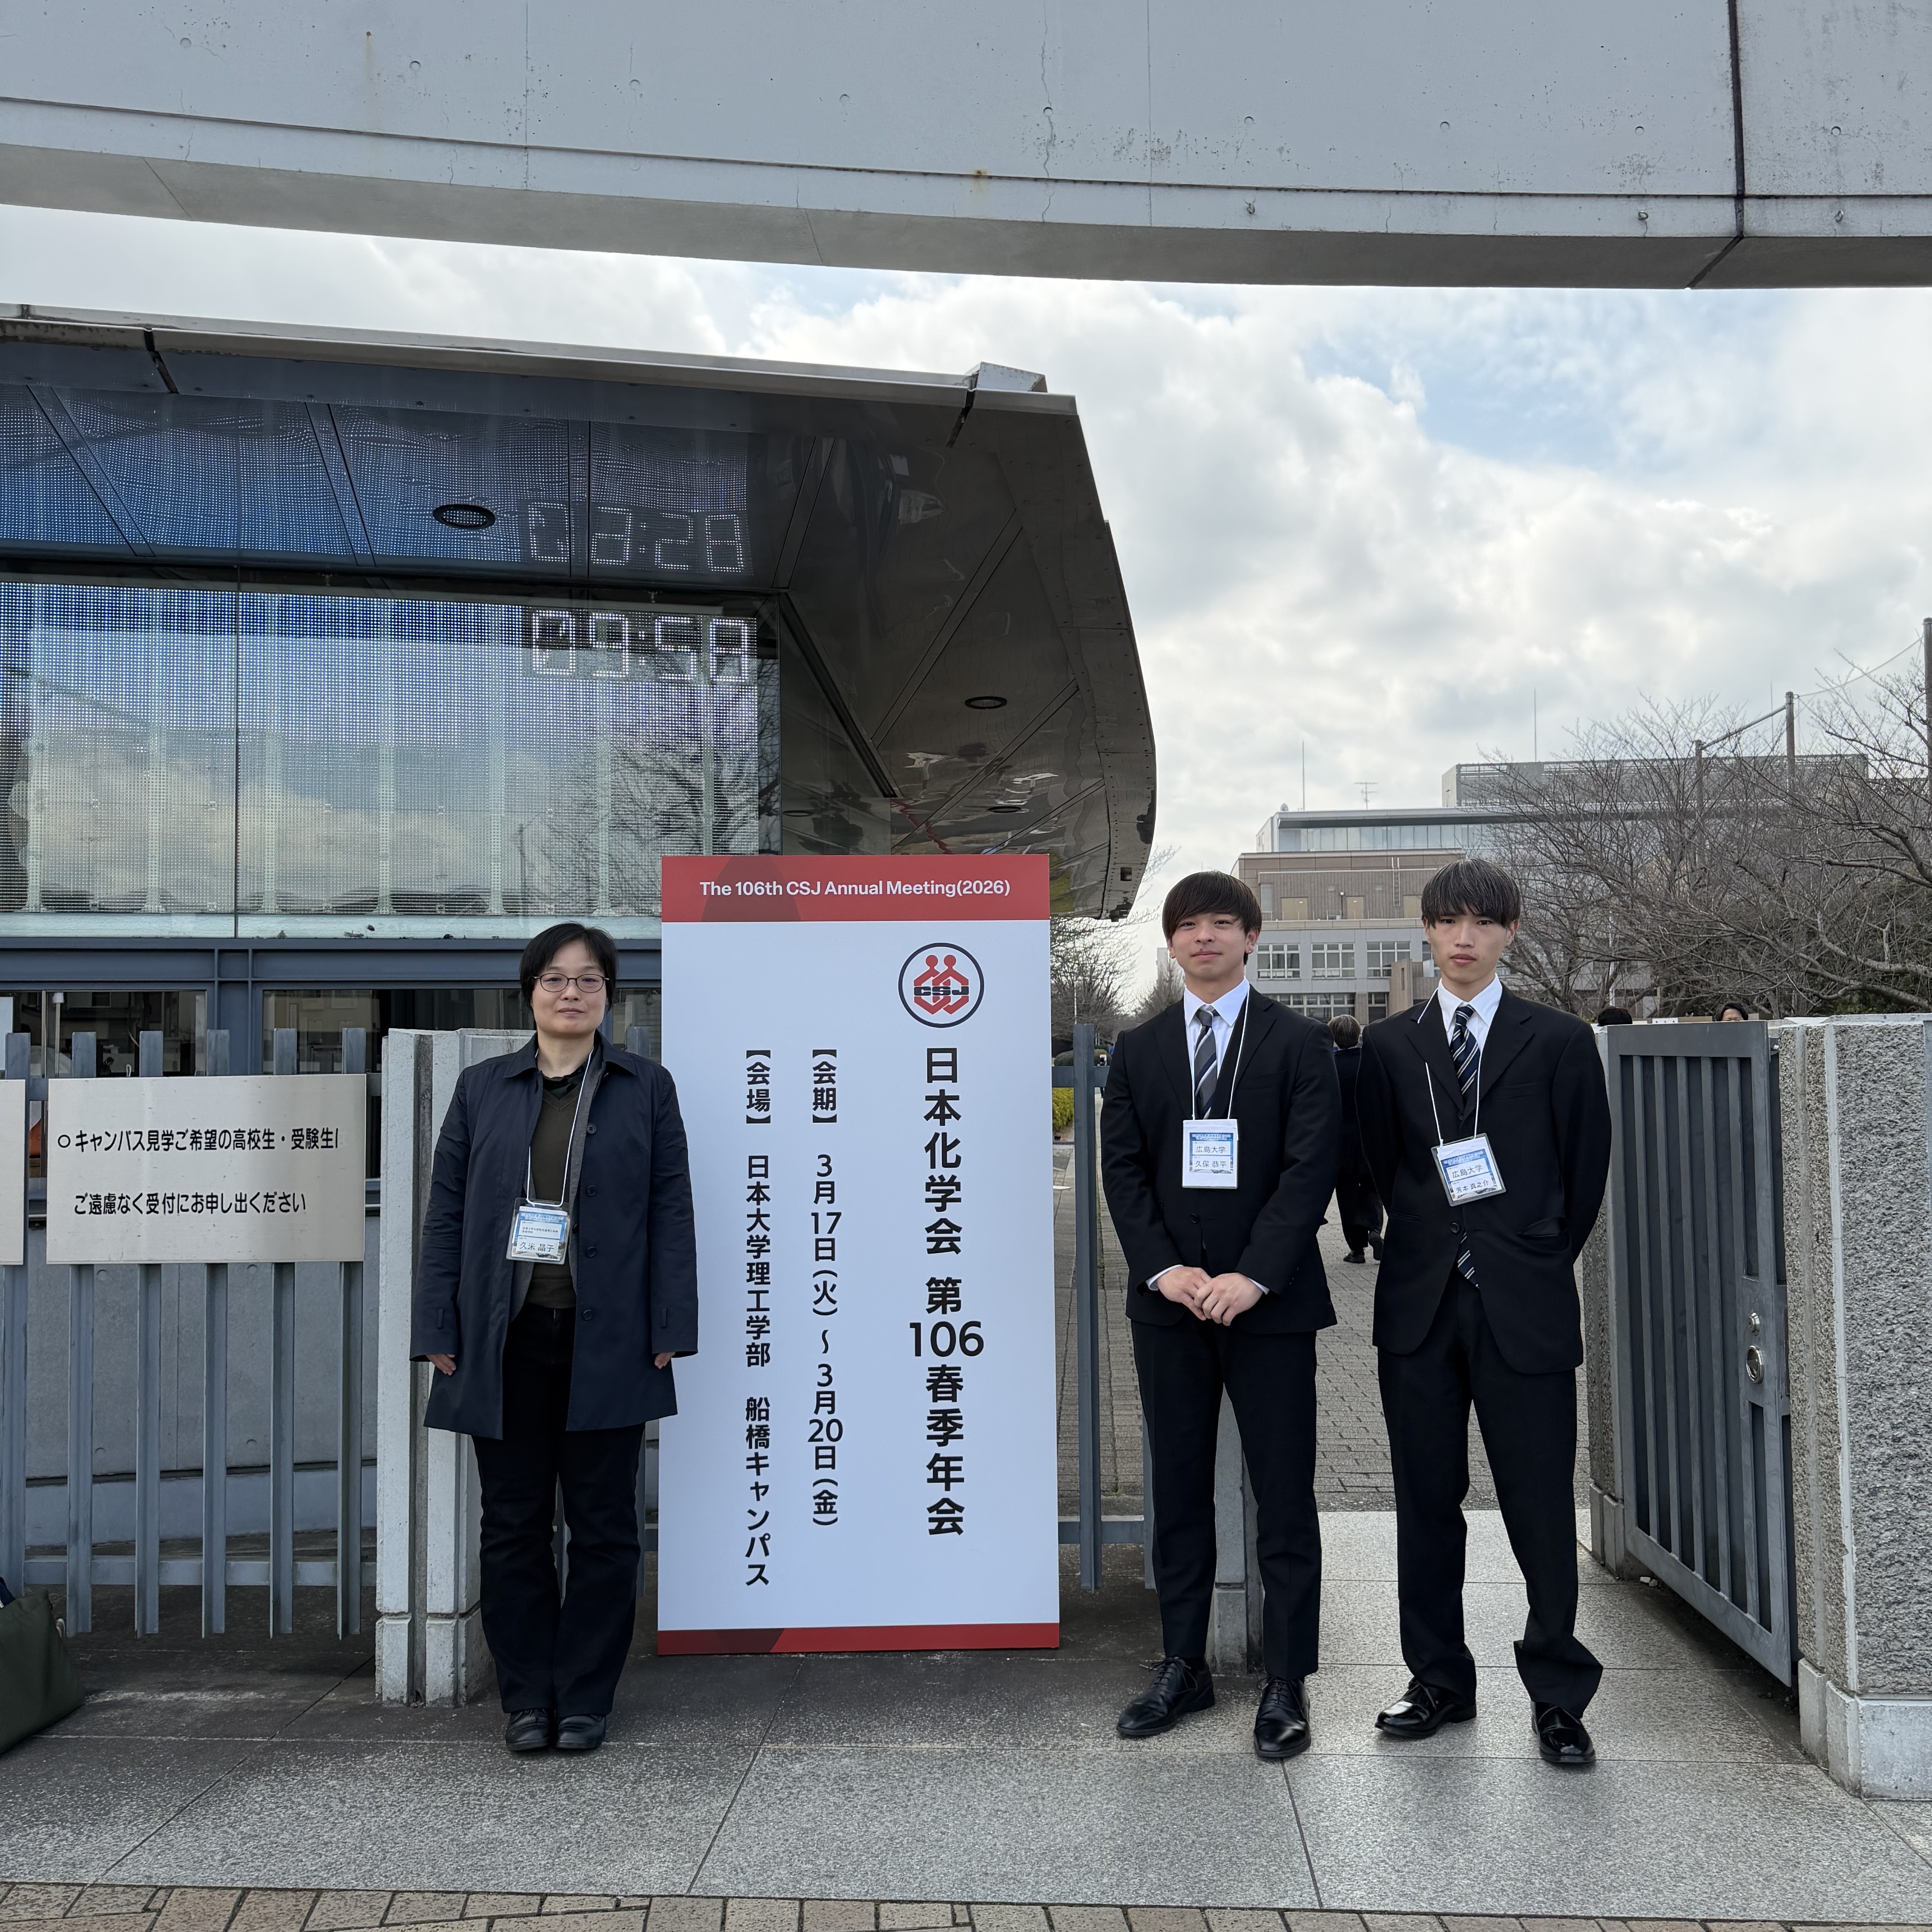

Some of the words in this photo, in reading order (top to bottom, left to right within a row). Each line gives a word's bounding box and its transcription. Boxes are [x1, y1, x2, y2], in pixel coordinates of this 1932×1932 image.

[700, 882, 732, 896] The
[736, 881, 783, 896] 106th
[787, 881, 821, 896] CSJ
[825, 881, 883, 895] Annual
[887, 880, 1011, 898] Meeting(2026)
[914, 986, 969, 996] CSJ
[924, 1048, 963, 1255] 日本化学会
[1453, 1165, 1483, 1178] 広島大学
[75, 1191, 306, 1215] ご遠慮なく受付にお申し出ください
[520, 1242, 535, 1250] 久米
[746, 1155, 771, 1368] 日本大学理工学部
[910, 1277, 984, 1536] 第106春季年会
[745, 1397, 771, 1587] 船橋キャンパス
